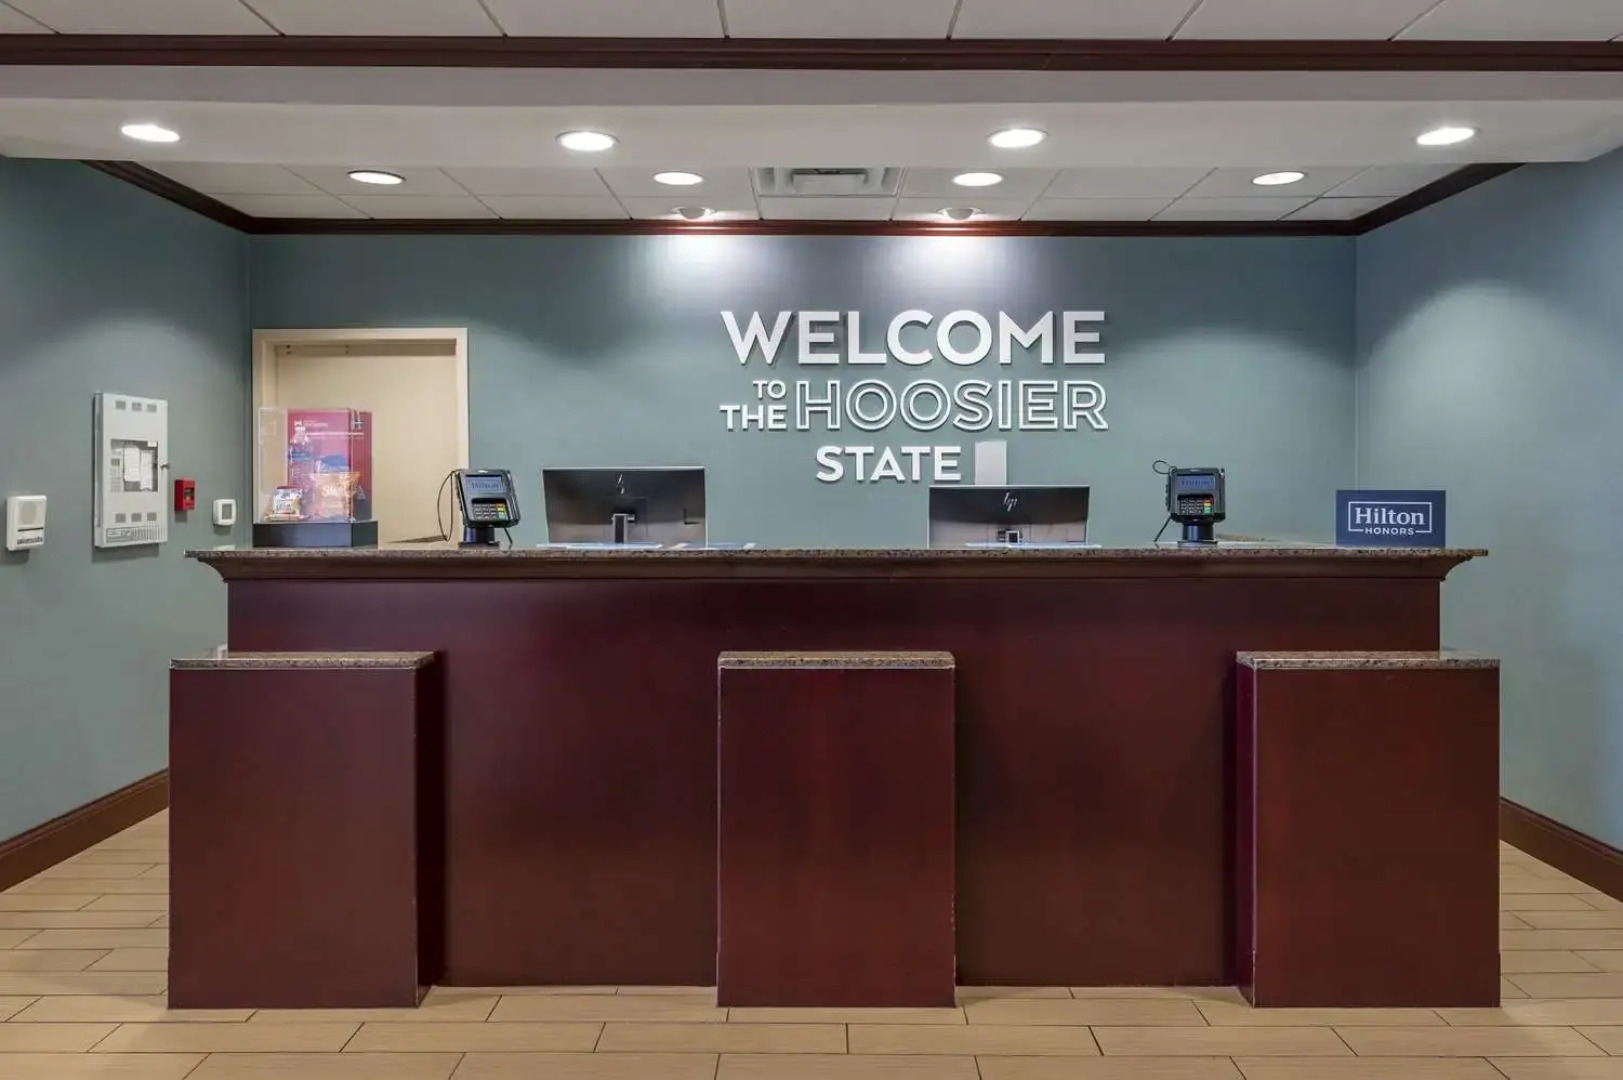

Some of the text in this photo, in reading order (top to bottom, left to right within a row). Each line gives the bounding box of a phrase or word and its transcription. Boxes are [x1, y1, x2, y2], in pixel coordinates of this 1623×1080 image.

[720, 310, 1105, 365] WELCOME
[753, 380, 787, 399] TO
[720, 379, 1109, 431] THE HOOSIER
[816, 445, 962, 482] STATE
[1355, 507, 1425, 525] Hilton
[1364, 527, 1415, 536] HONORS
